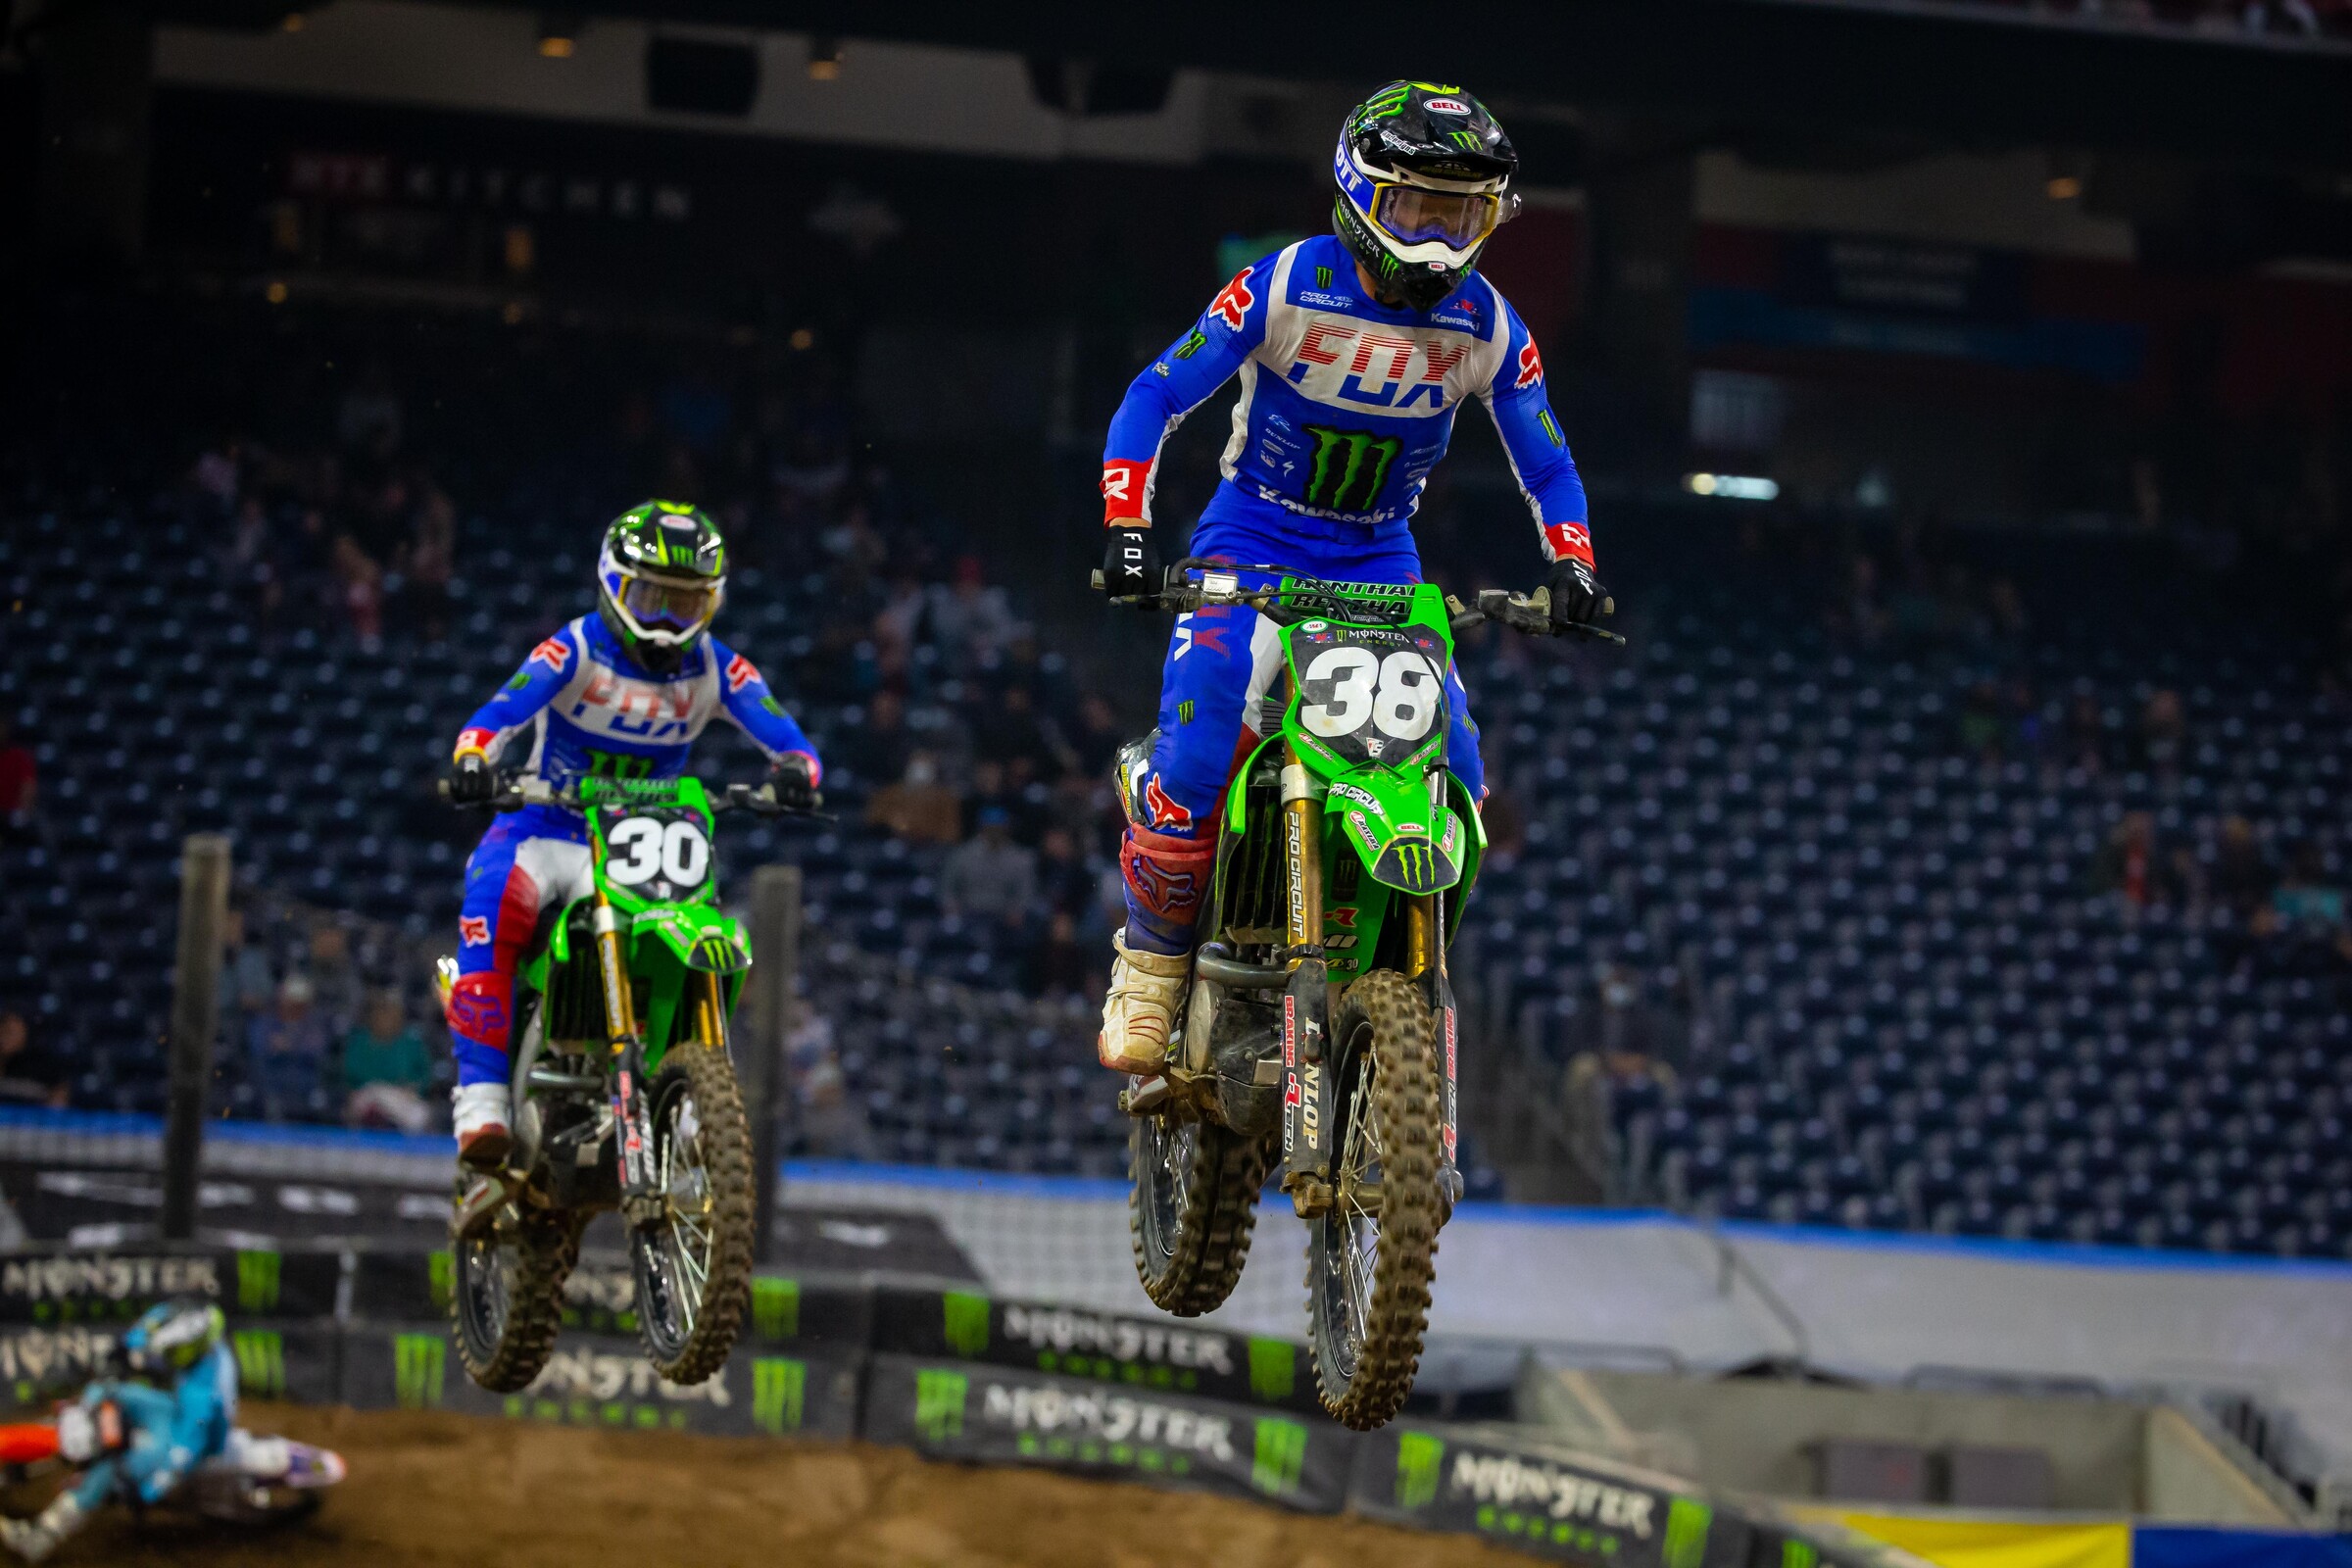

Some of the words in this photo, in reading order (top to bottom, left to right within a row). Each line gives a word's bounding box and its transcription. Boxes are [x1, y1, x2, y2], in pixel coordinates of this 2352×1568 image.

[1432, 102, 1465, 113] BELL
[1335, 131, 1363, 192] OTT
[1339, 198, 1381, 258] MONSTER
[1299, 295, 1352, 309] CIRCUIT
[1300, 290, 1331, 300] PRO
[1431, 313, 1480, 332] Kawaski
[1286, 321, 1470, 409] FOX
[1265, 427, 1301, 450] DUNLOP
[1123, 532, 1144, 578] FOX
[1301, 646, 1443, 741] 38
[605, 816, 710, 888] 30
[1289, 811, 1300, 856] PRO
[1291, 857, 1304, 938] CIRCUIT
[1285, 995, 1296, 1068] BRAKING
[1446, 1005, 1456, 1083] BRAKING
[1302, 1016, 1321, 1151] DNLOP
[2, 1255, 221, 1301] MONSTER
[1003, 1305, 1233, 1374] MONSTER
[984, 1382, 1235, 1462] MONSTER
[1452, 1450, 1656, 1540] MONSTER
